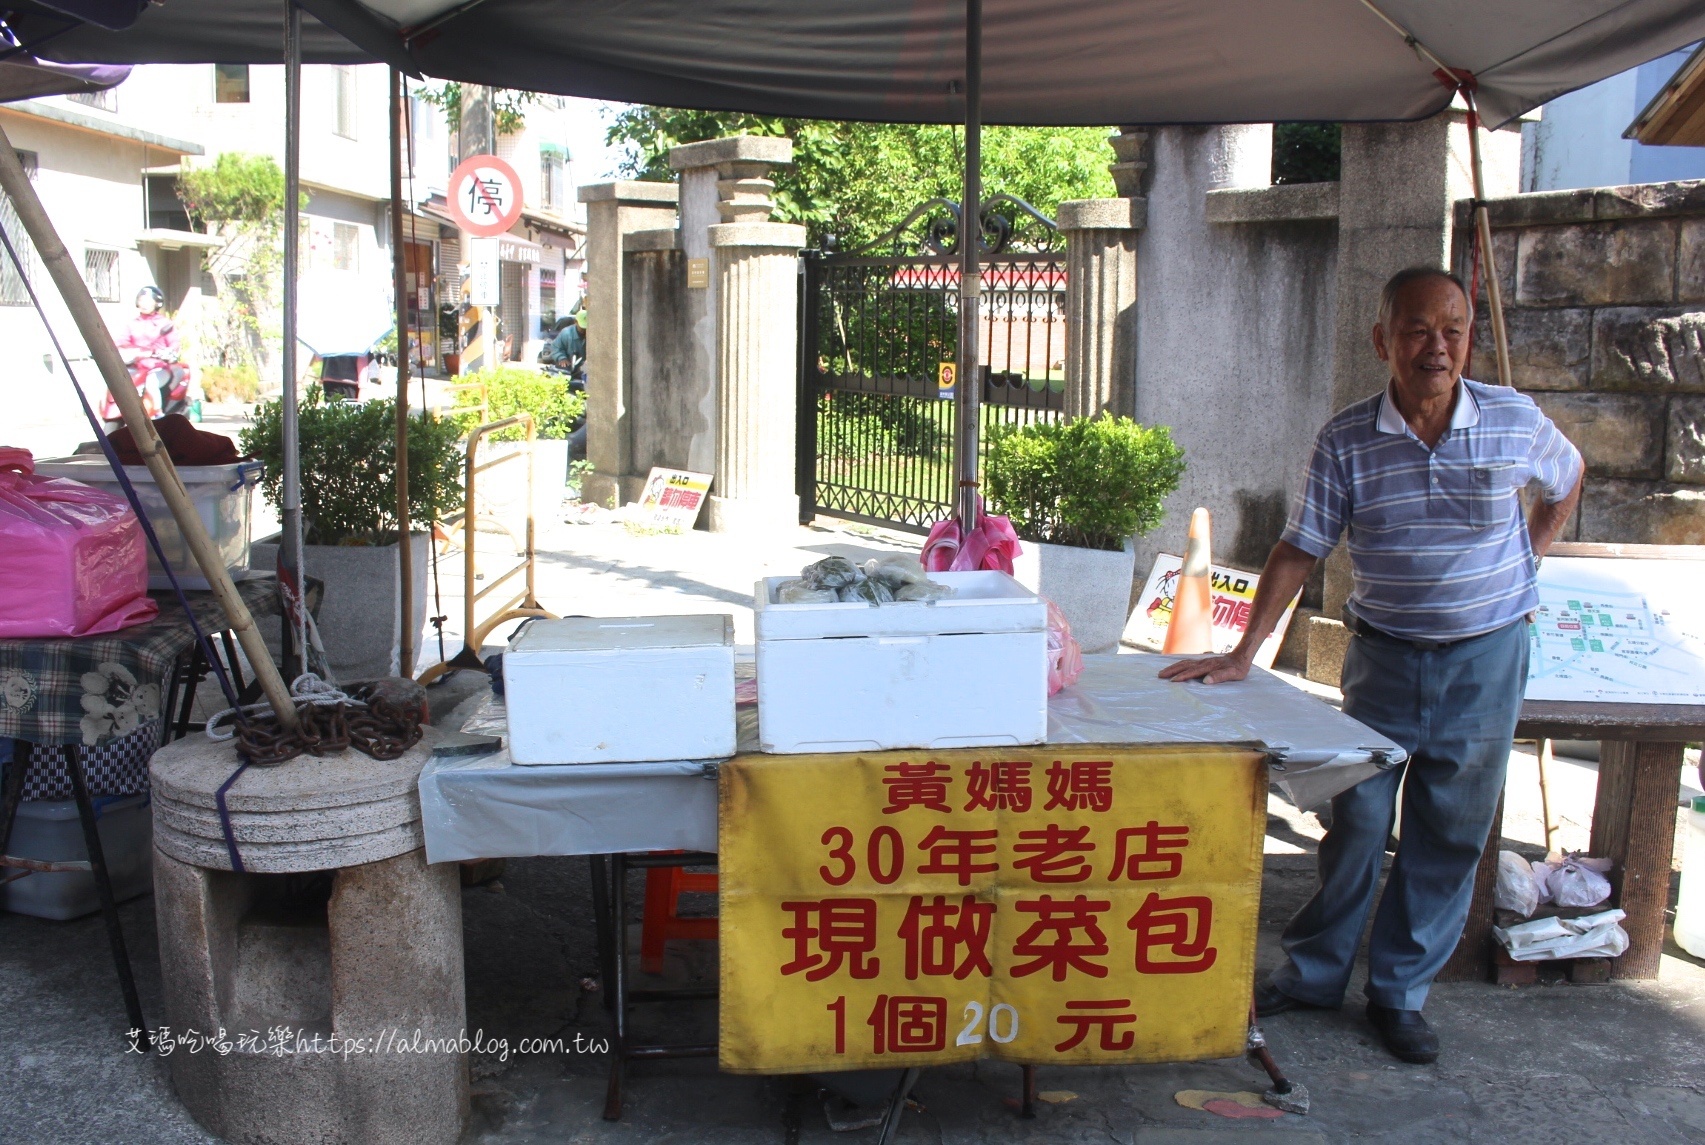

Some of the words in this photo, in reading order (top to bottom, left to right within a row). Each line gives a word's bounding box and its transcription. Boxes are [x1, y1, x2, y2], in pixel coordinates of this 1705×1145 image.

[468, 177, 503, 215] 停
[669, 474, 690, 486] 出入口
[883, 761, 1112, 813] 黃媽媽
[820, 821, 1189, 885] 30年老店
[781, 893, 1217, 981] 現做菜包
